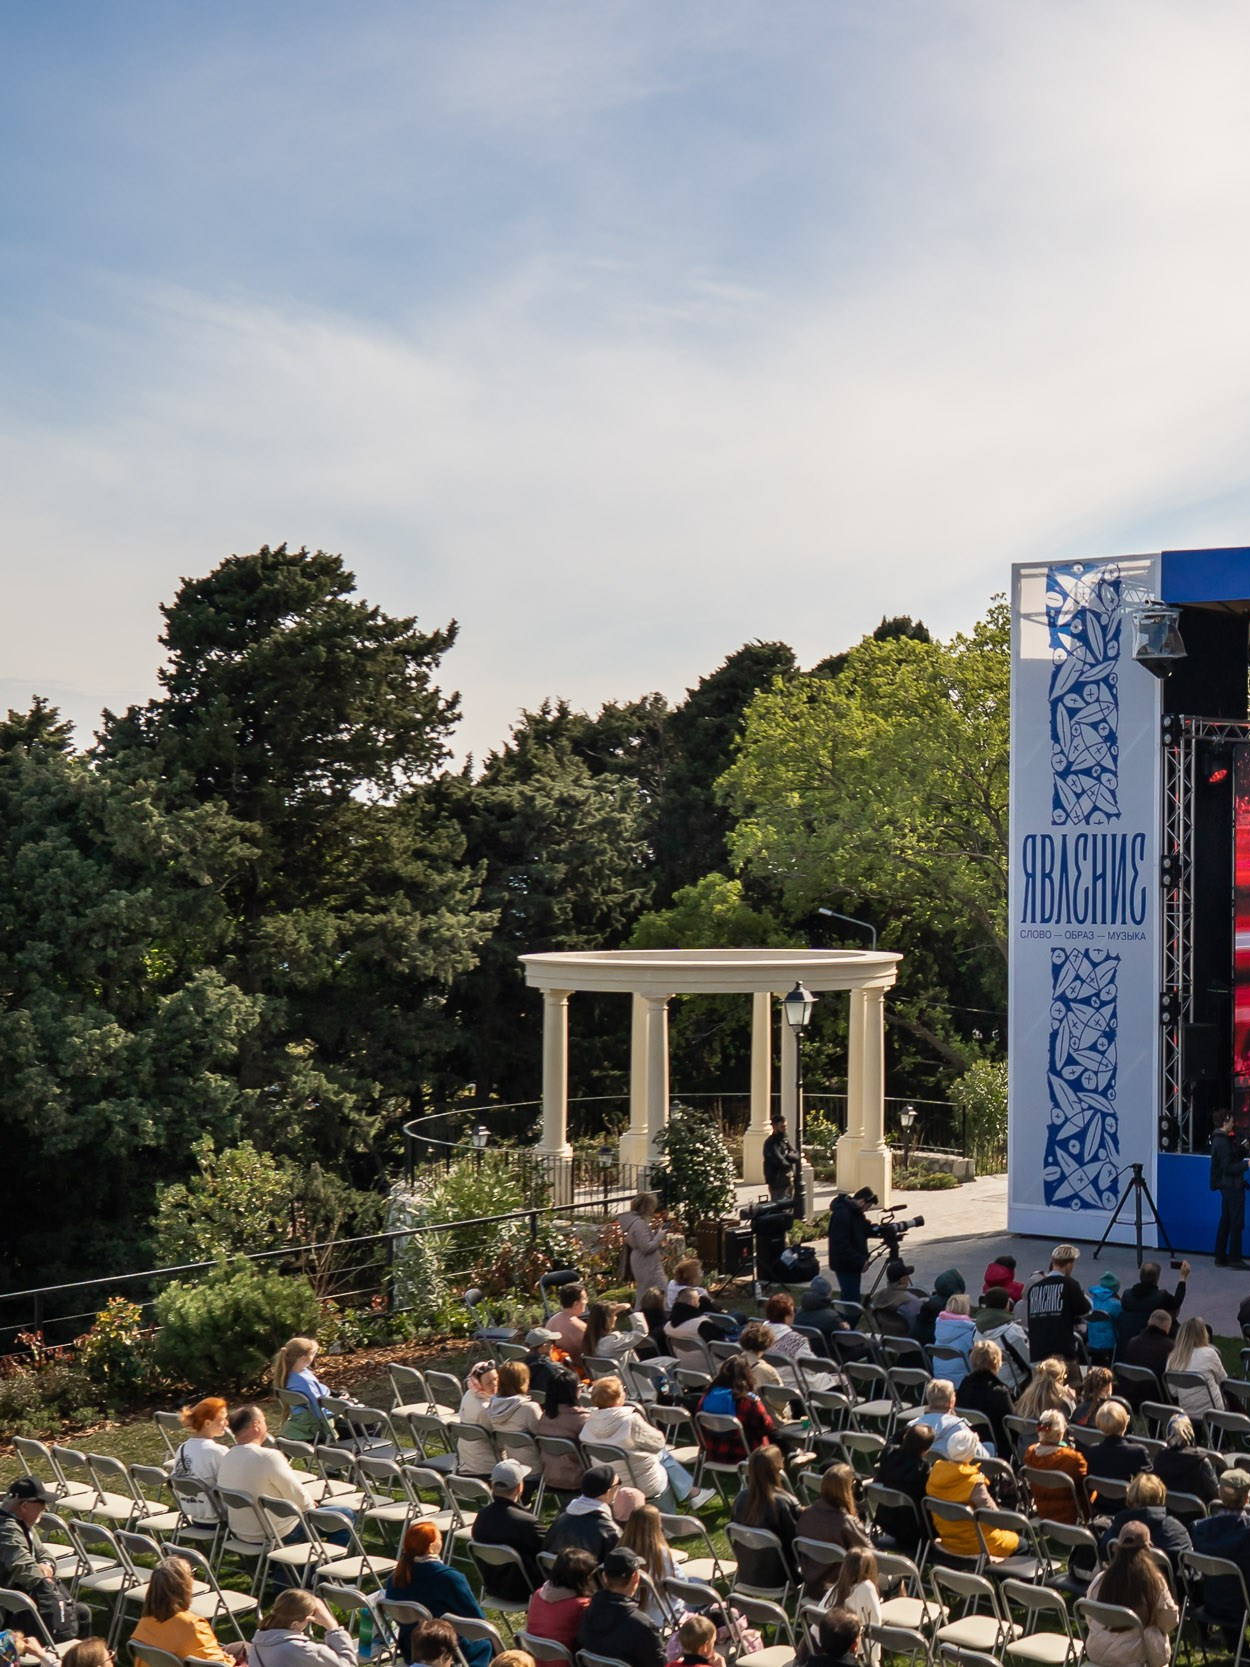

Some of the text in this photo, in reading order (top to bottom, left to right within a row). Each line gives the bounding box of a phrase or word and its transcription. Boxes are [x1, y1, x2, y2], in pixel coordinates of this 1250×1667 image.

[1020, 833, 1147, 926] ЯВЛЕНИЕ
[1020, 930, 1147, 941] СЛОВО ОБРАЗ МУЗЫКА
